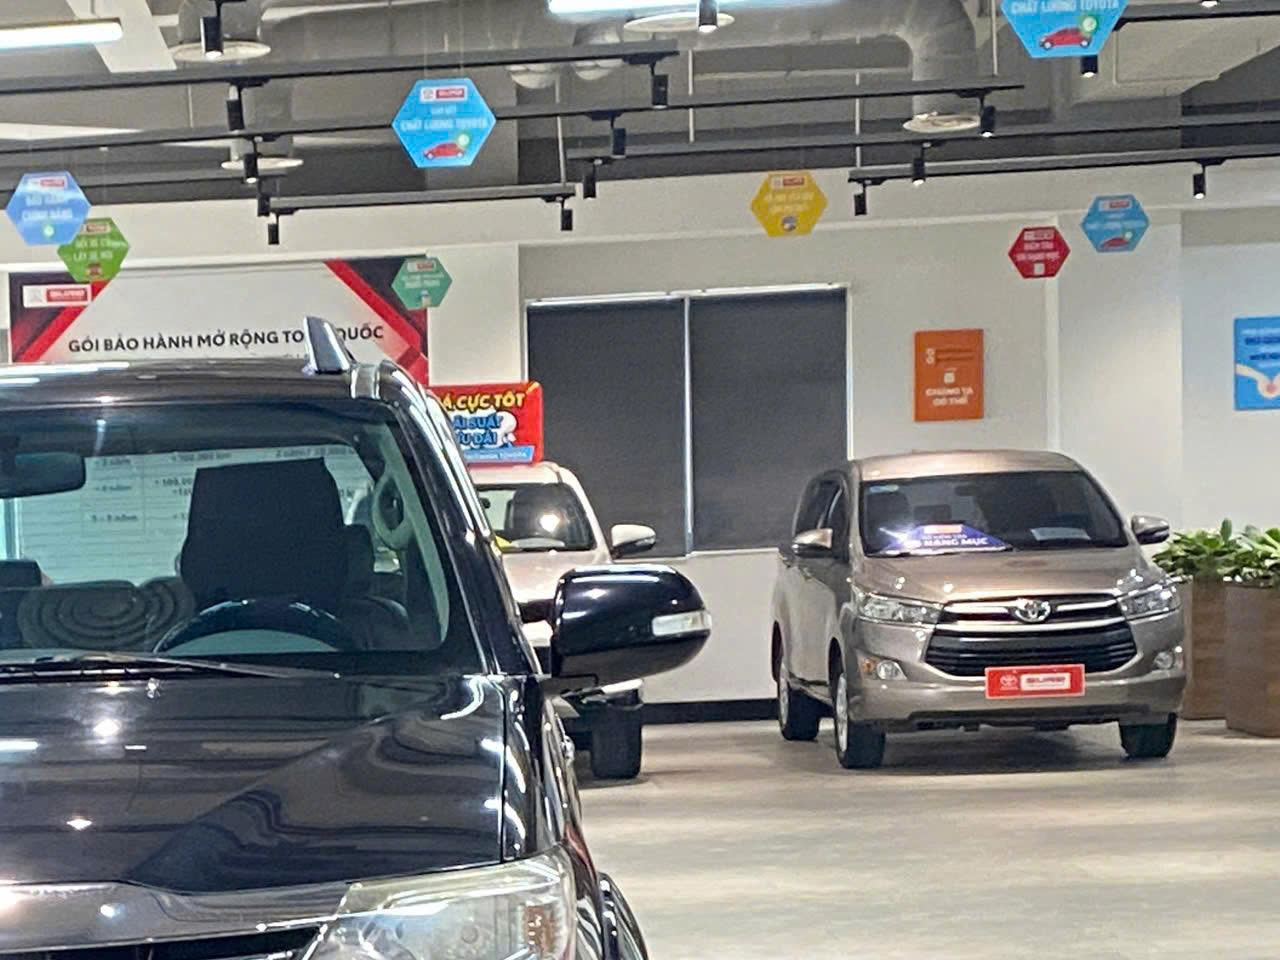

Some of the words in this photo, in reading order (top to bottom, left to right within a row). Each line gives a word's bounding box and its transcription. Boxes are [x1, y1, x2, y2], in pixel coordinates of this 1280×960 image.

[68, 337, 99, 352] GÓI
[104, 333, 139, 351] BẢO
[143, 332, 193, 350] HÀNH
[230, 328, 279, 349] RỘNG
[493, 389, 525, 408] TỐT
